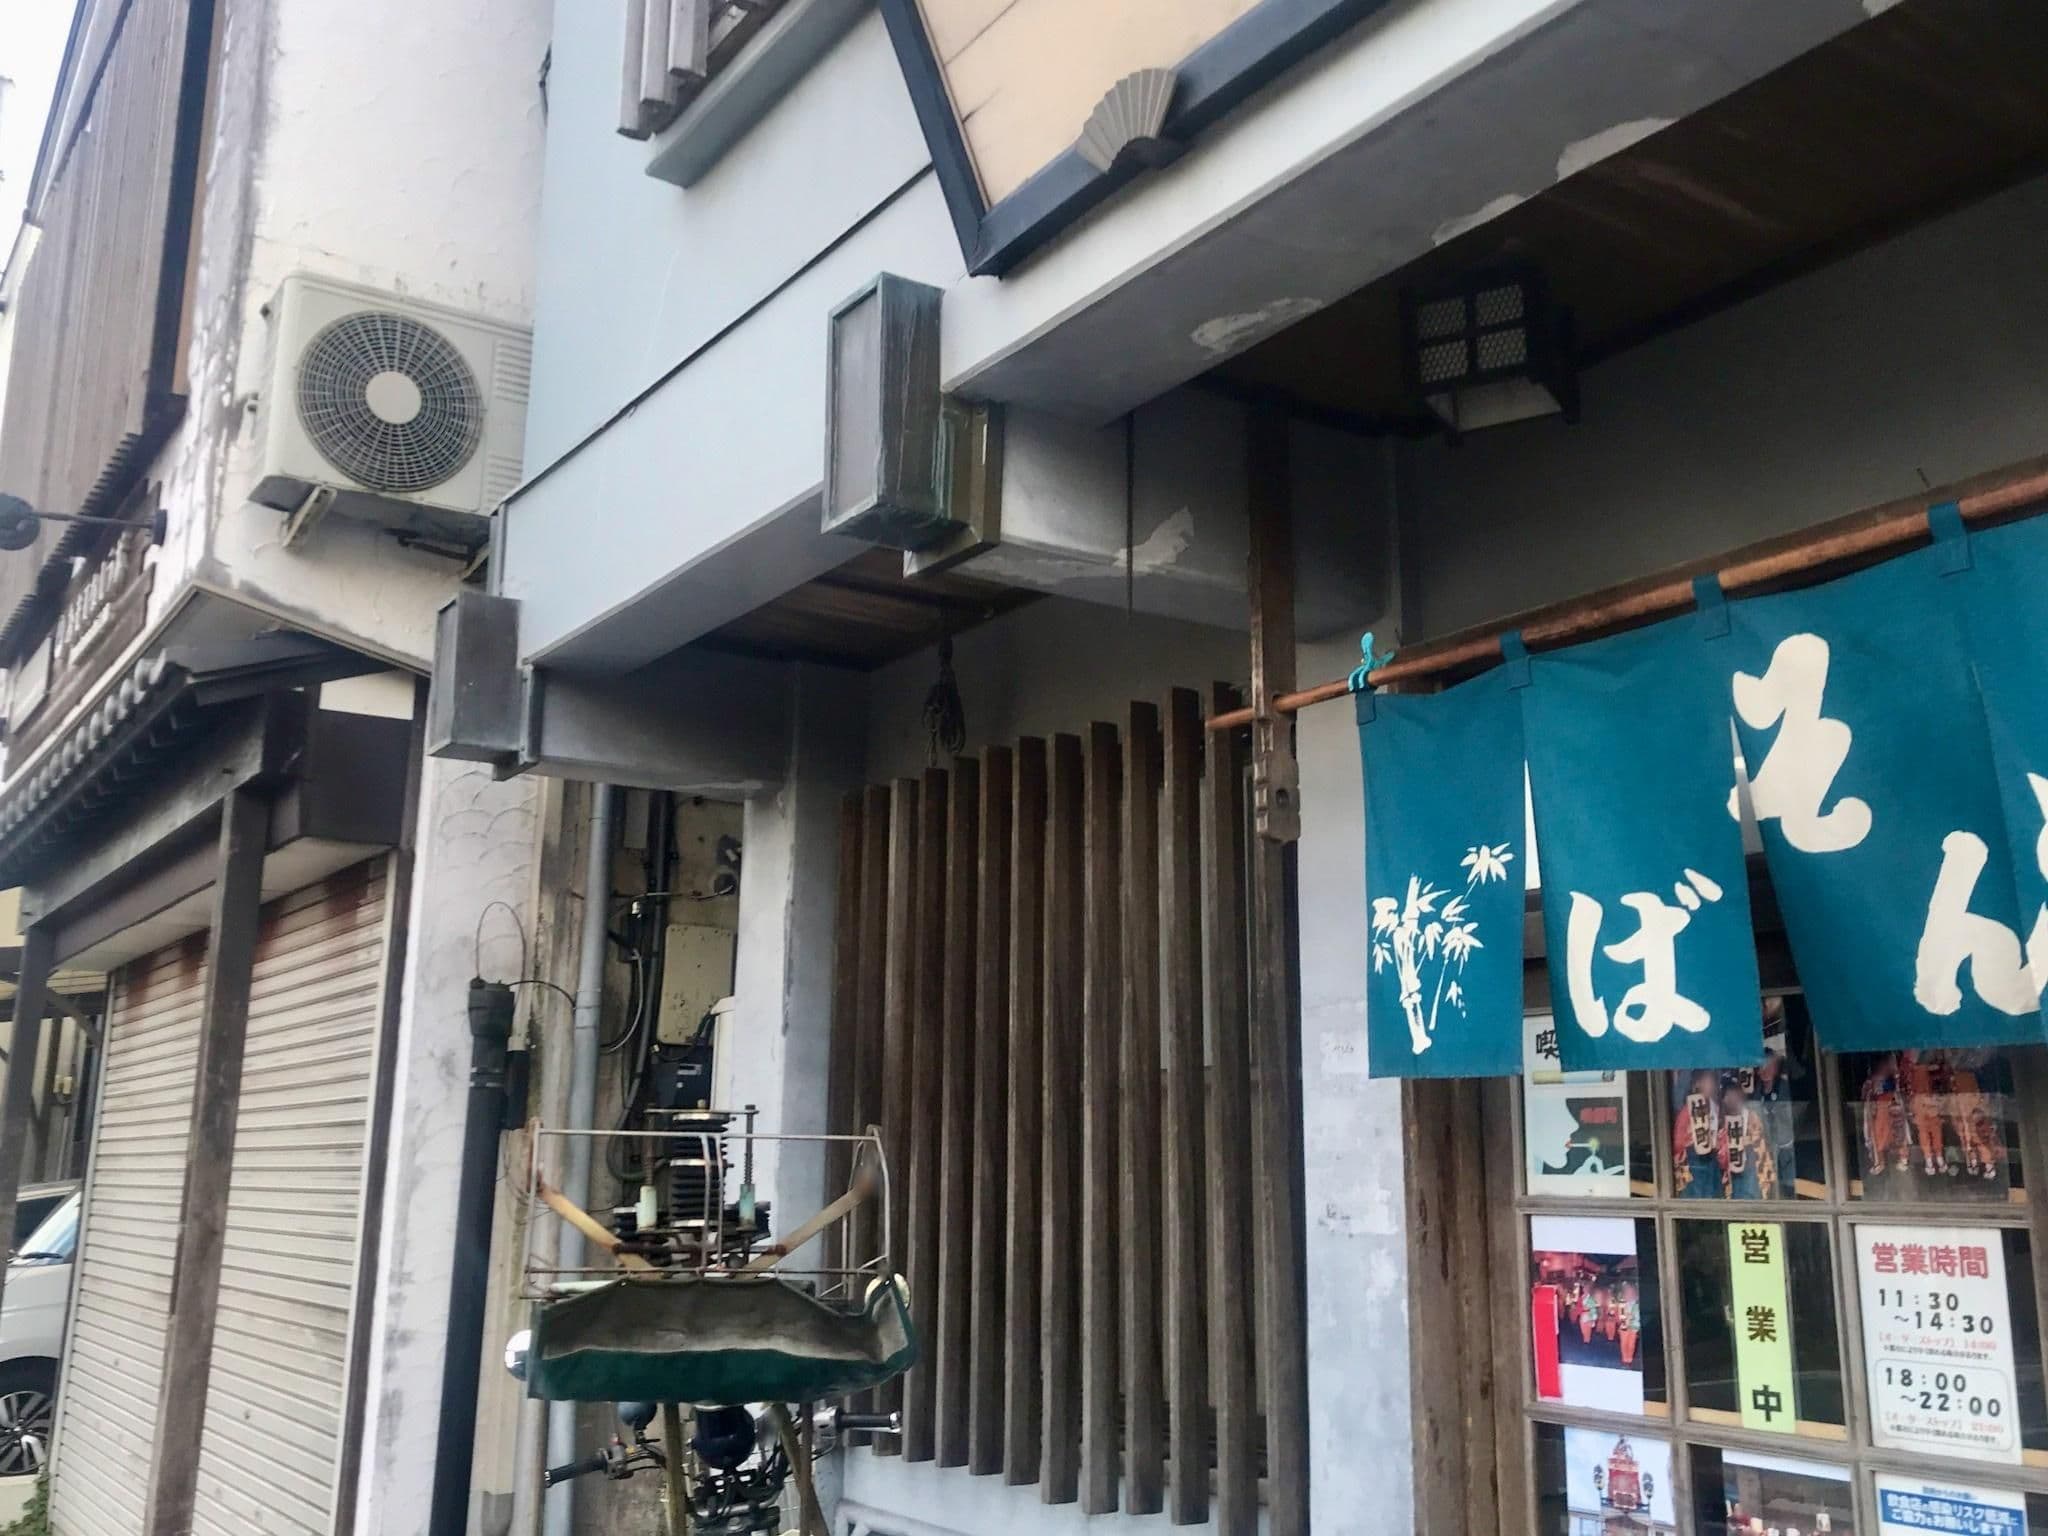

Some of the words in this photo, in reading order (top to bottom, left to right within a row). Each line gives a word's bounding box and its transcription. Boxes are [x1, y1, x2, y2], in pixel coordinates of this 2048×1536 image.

[1872, 1242, 1989, 1279] 営業時間
[1879, 1288, 1960, 1312] 11:30
[1741, 1229, 1782, 1422] 営業中
[1886, 1367, 1967, 1393] 18:00
